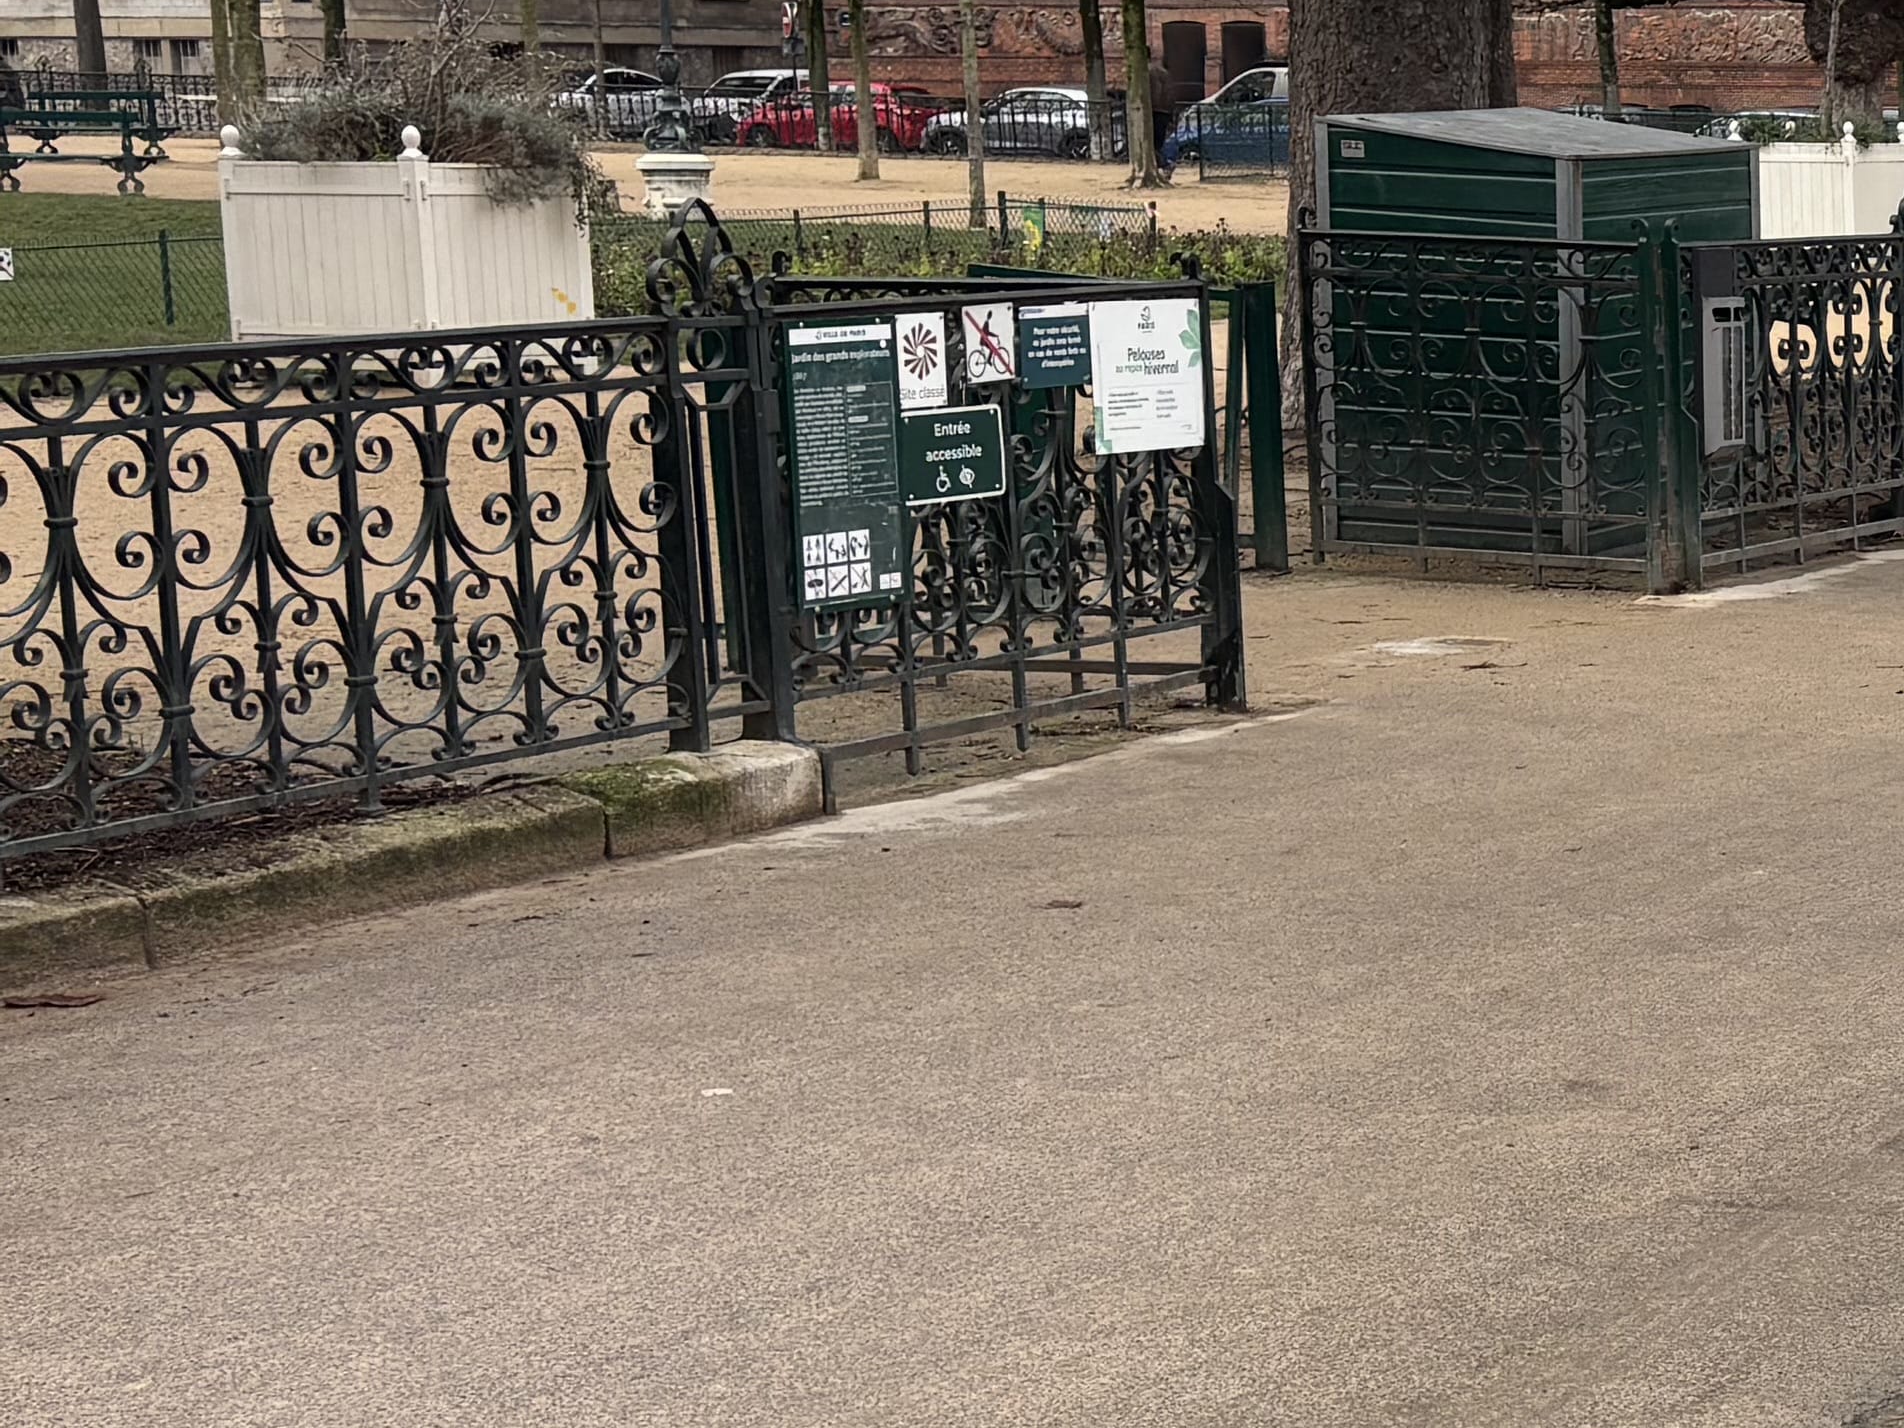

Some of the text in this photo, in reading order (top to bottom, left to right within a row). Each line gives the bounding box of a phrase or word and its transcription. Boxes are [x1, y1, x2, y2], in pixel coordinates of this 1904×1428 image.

[1127, 348, 1166, 362] Pelouses
[899, 384, 945, 400] Site classé
[933, 420, 971, 437] Entrée
[925, 443, 983, 462] accessible
